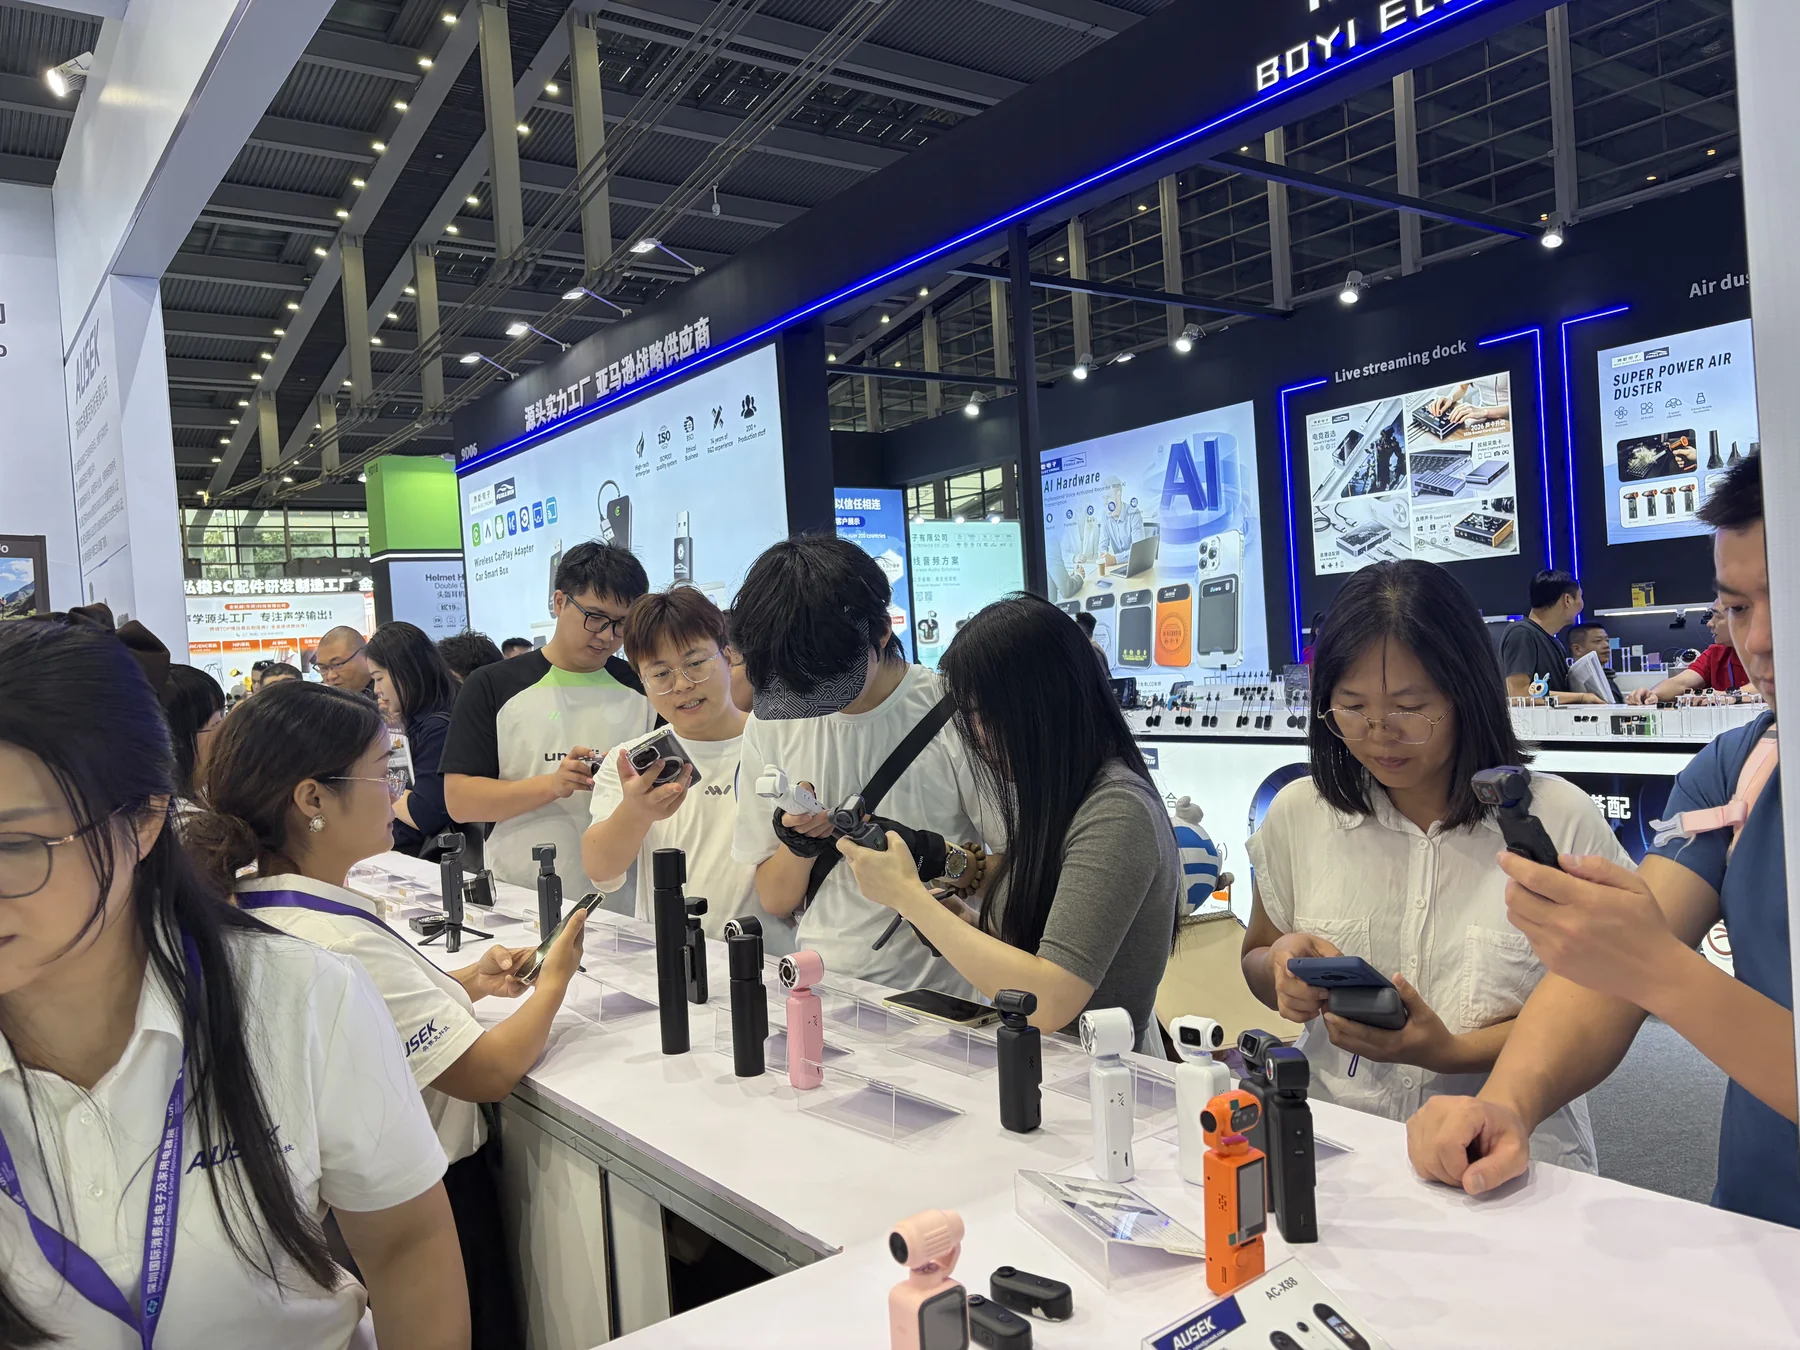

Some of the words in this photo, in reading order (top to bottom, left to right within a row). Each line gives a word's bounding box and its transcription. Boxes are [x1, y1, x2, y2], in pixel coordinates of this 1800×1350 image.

[1256, 18, 1356, 91] BOYI
[1380, 0, 1457, 34] EL
[1689, 278, 1717, 299] Air
[76, 318, 100, 405] AUSEK
[525, 375, 591, 432] 源头实力工厂
[596, 316, 711, 399] 亚马逊战略供应商
[1335, 367, 1361, 384] Live
[1362, 351, 1430, 376] streaming
[1432, 340, 1467, 360] dock
[1613, 368, 1654, 387] SUPER
[1659, 357, 1704, 378] POWER
[1708, 352, 1732, 369] AIR
[1614, 380, 1662, 400] DUSTER
[658, 430, 671, 444] ISO
[461, 443, 478, 462] 9D06
[1044, 479, 1053, 493] AI
[1056, 472, 1100, 490] Hardware
[1159, 436, 1219, 511] AI
[835, 497, 881, 510] 以信任相连
[912, 533, 948, 542] 子有限公司
[474, 555, 494, 568] Wireless
[494, 549, 513, 562] CarPlay
[514, 544, 534, 557] Adapter
[913, 556, 959, 566] 线音频方案
[475, 571, 484, 582] Car
[484, 569, 498, 580] Smart
[499, 566, 509, 577] Box
[146, 1128, 176, 1294] 深圳国际消费类电子及家用电器展
[165, 1195, 173, 1226] Electronics
[162, 1227, 171, 1264] International
[1265, 1276, 1299, 1301] AC-X88
[1172, 1315, 1216, 1350] AUSEK
